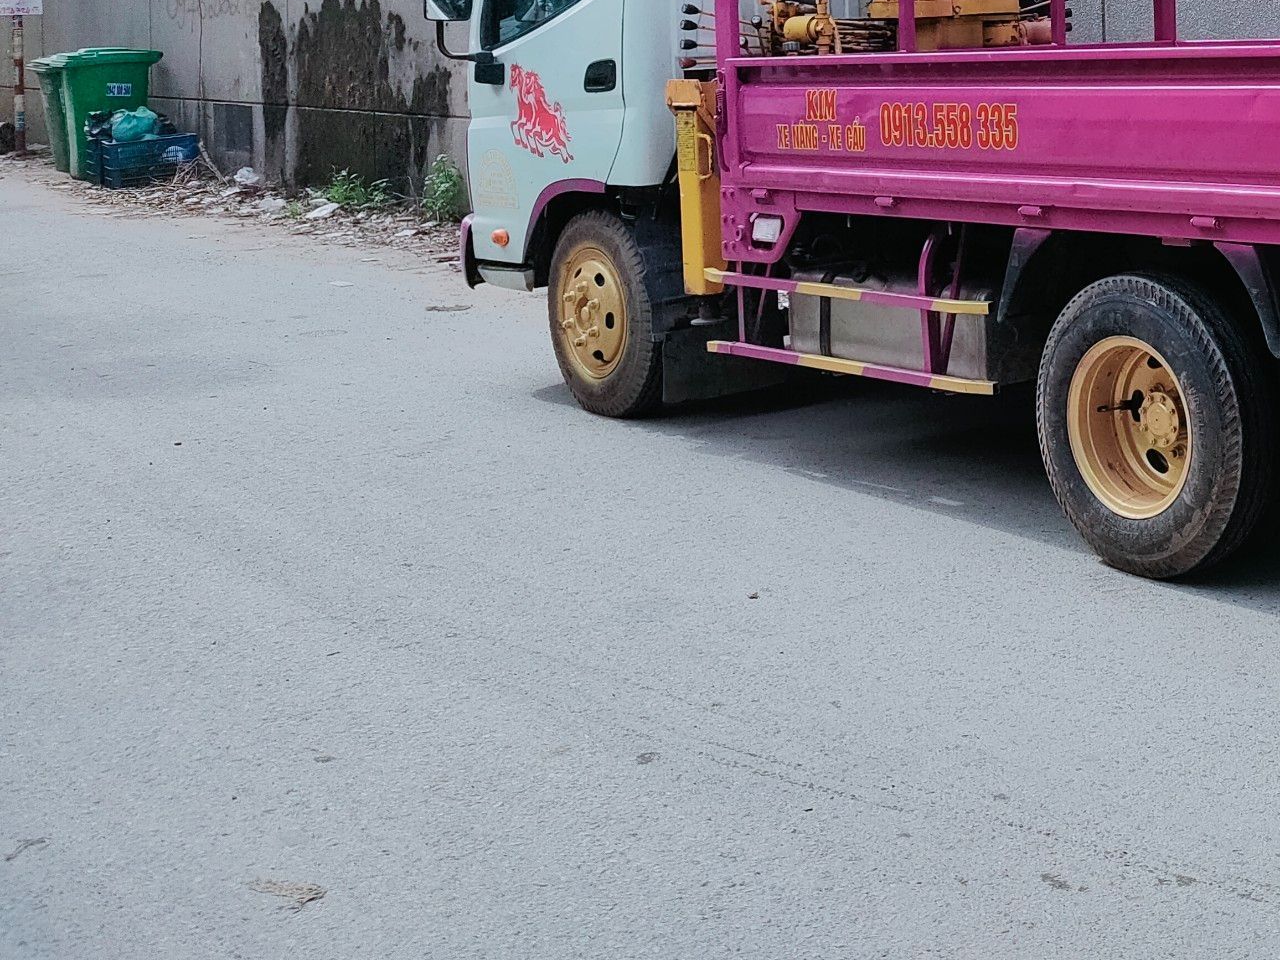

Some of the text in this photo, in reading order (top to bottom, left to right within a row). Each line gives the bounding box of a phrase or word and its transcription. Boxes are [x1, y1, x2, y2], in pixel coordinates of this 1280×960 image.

[805, 89, 837, 121] KIM
[777, 124, 790, 150] XE
[791, 120, 819, 151] NÂNG
[829, 124, 842, 151] XE
[880, 102, 1018, 151] 0913.558 335
